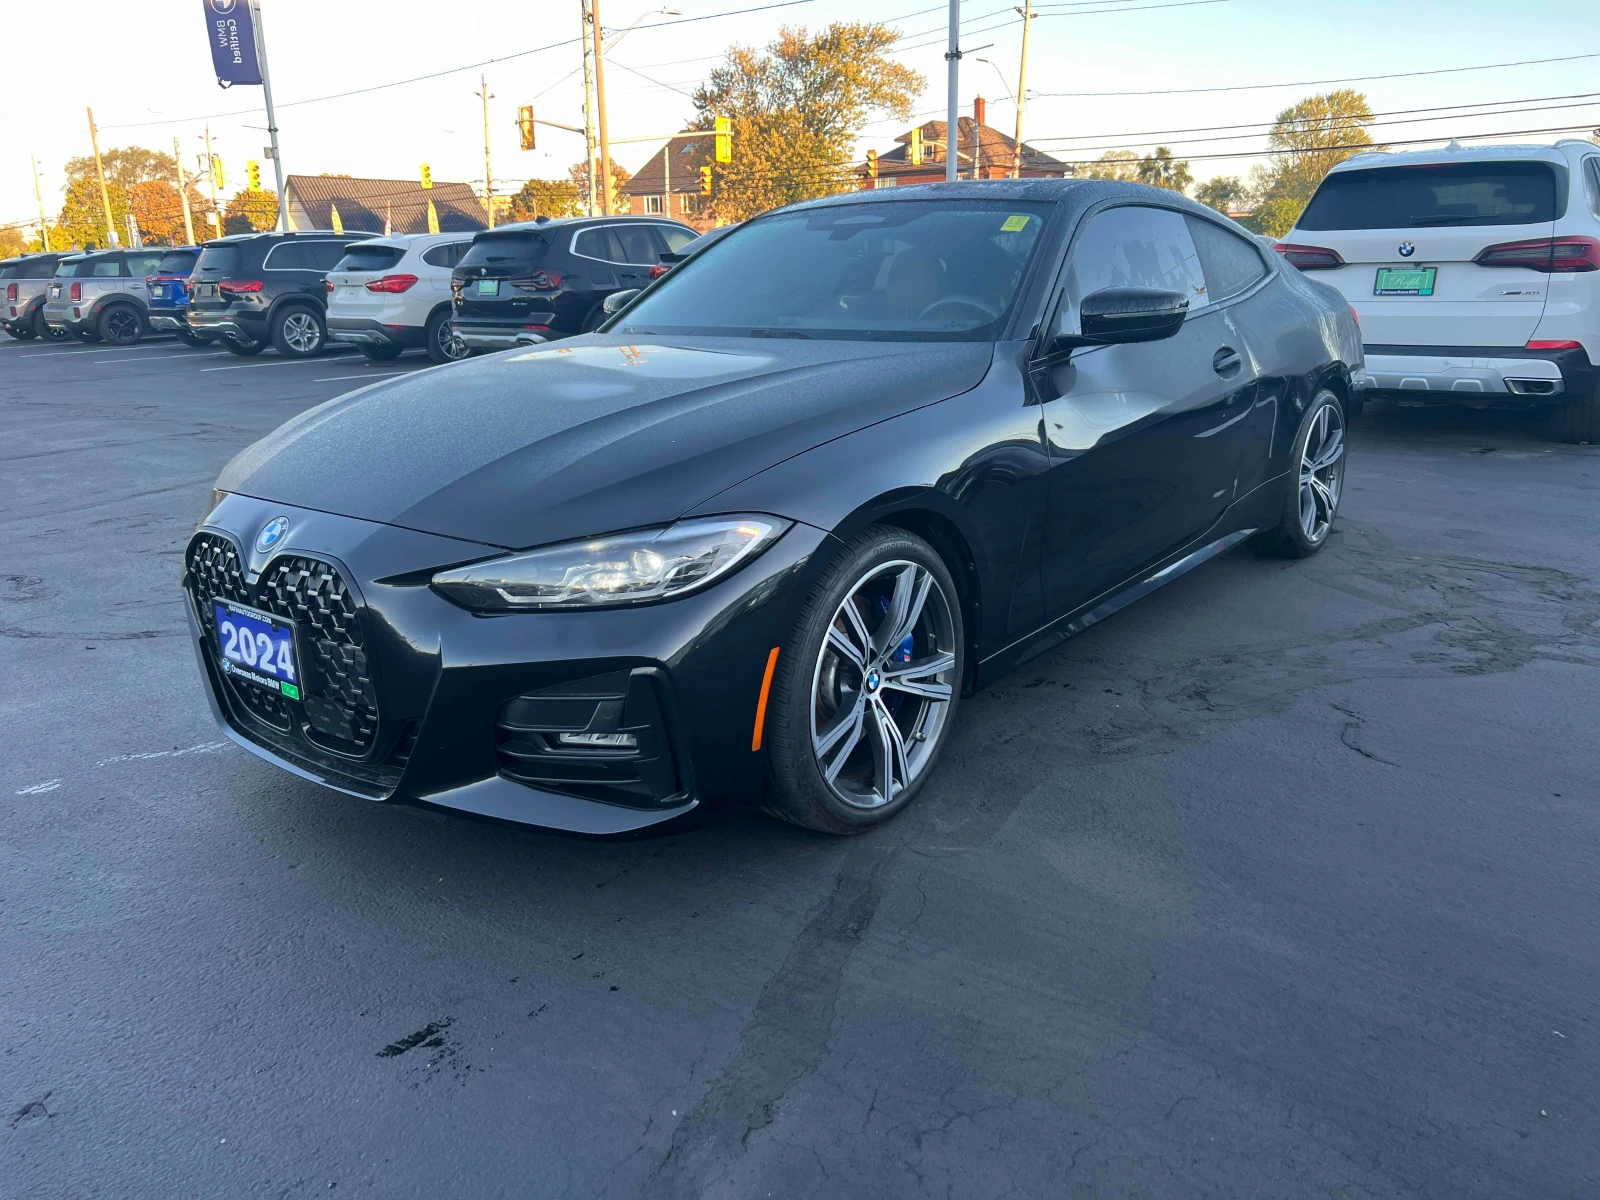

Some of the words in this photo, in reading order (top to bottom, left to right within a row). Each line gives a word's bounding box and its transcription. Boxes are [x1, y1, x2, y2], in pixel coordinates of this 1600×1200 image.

[221, 621, 295, 680] 2024
[231, 664, 251, 679] Overseas
[251, 671, 268, 684] Motors
[267, 677, 280, 690] BMW
